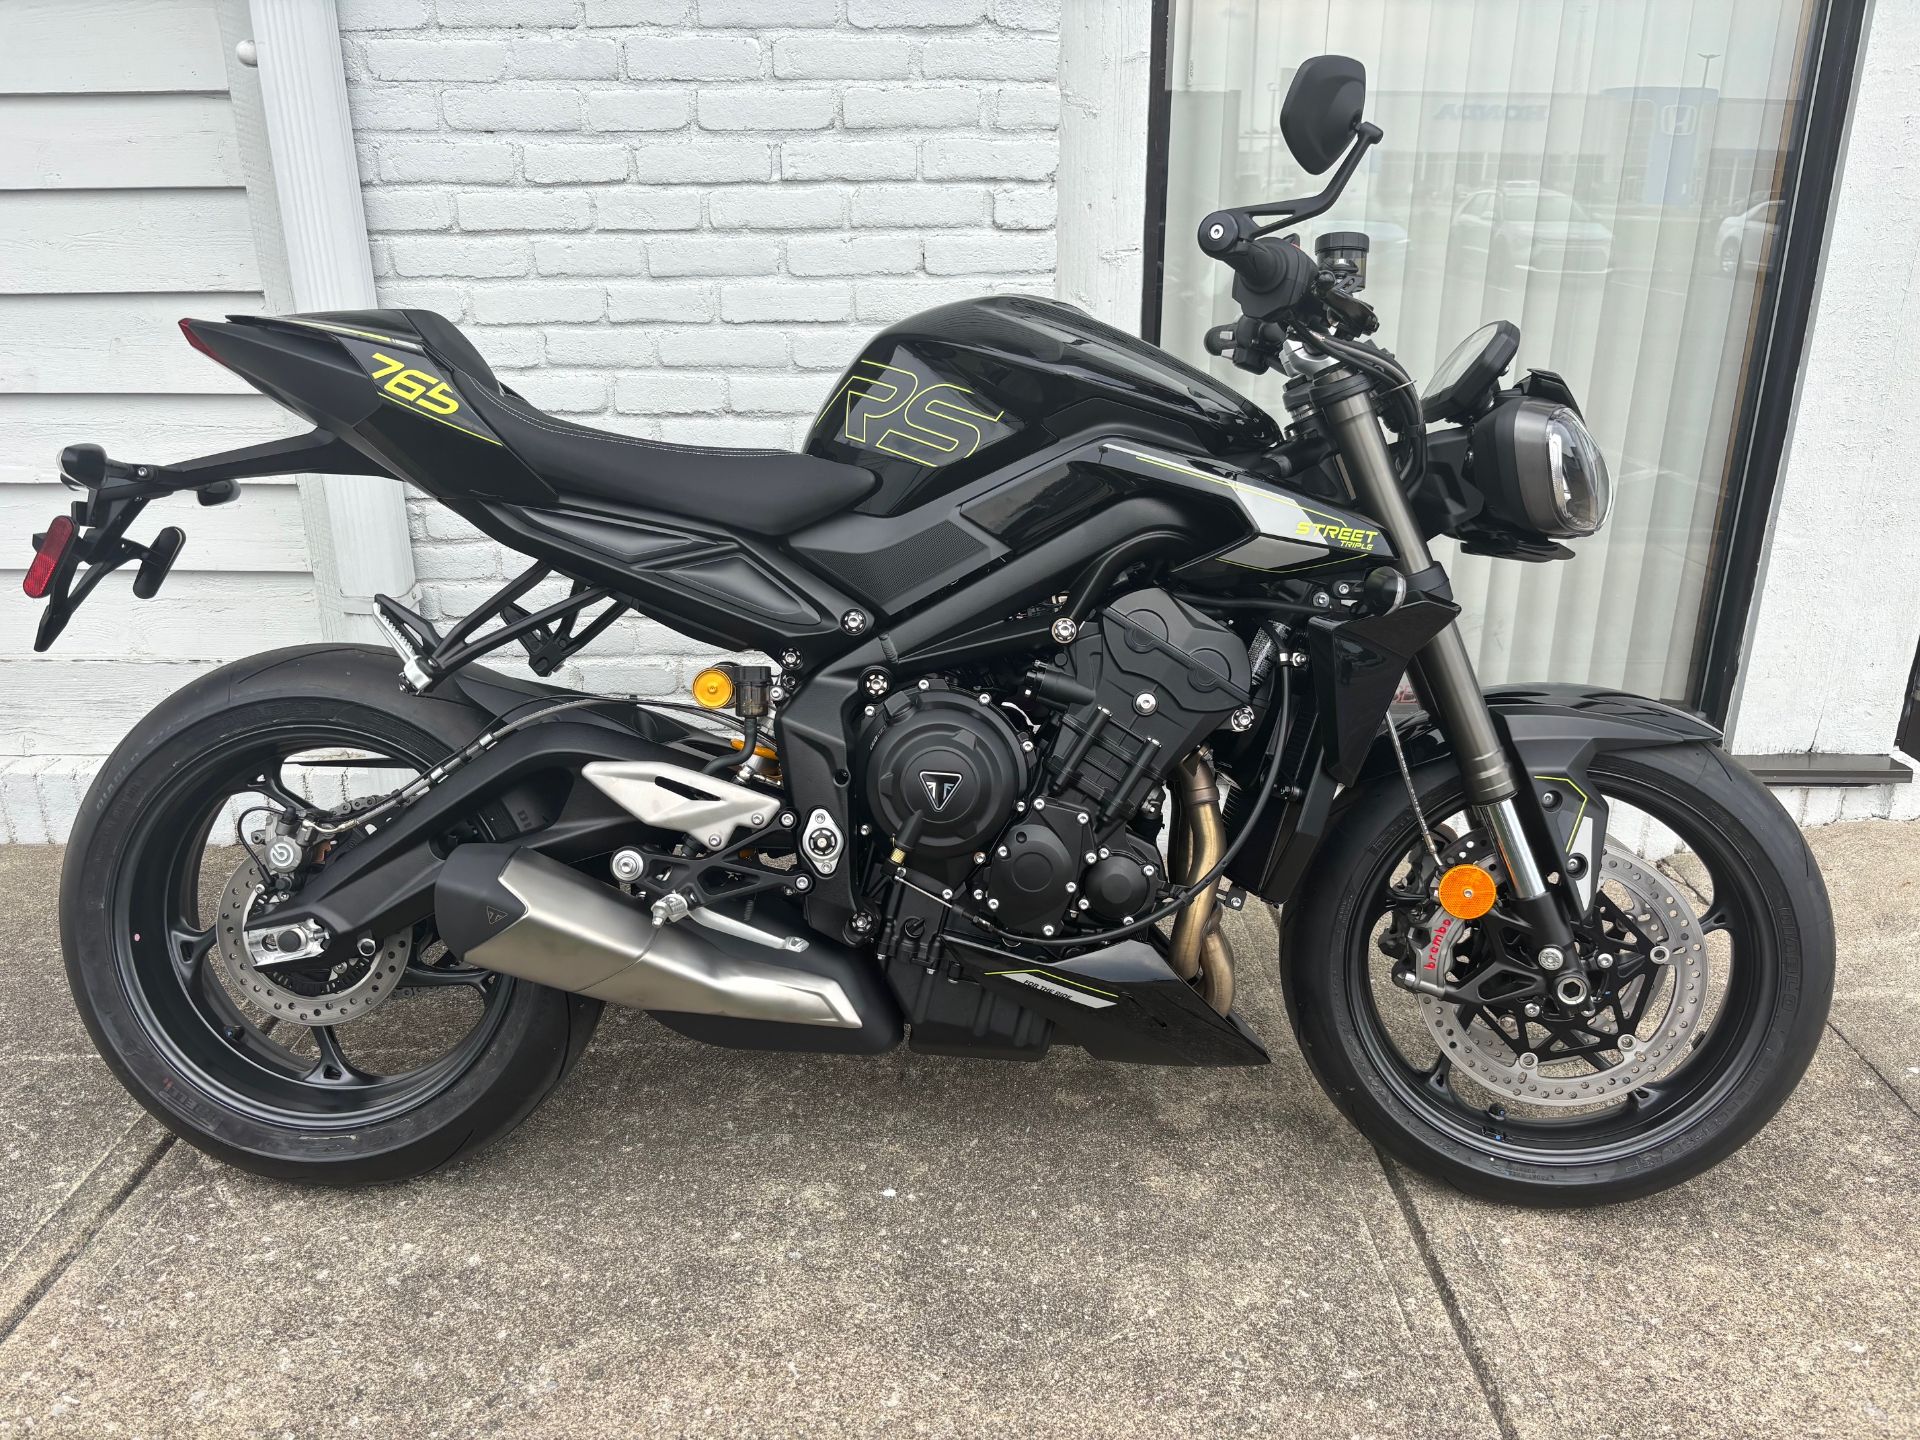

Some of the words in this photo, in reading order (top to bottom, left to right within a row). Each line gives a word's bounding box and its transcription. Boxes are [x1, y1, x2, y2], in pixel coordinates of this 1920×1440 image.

[371, 352, 460, 415] 765
[815, 359, 1005, 468] RS
[1295, 521, 1379, 544] STREET
[1339, 540, 1374, 551] TRIPLE
[1423, 918, 1452, 971] brembo
[1777, 907, 1800, 1012] DIABLO
[1022, 979, 1040, 990] FOR
[1040, 985, 1055, 995] THE
[1054, 989, 1073, 1001] RIDE
